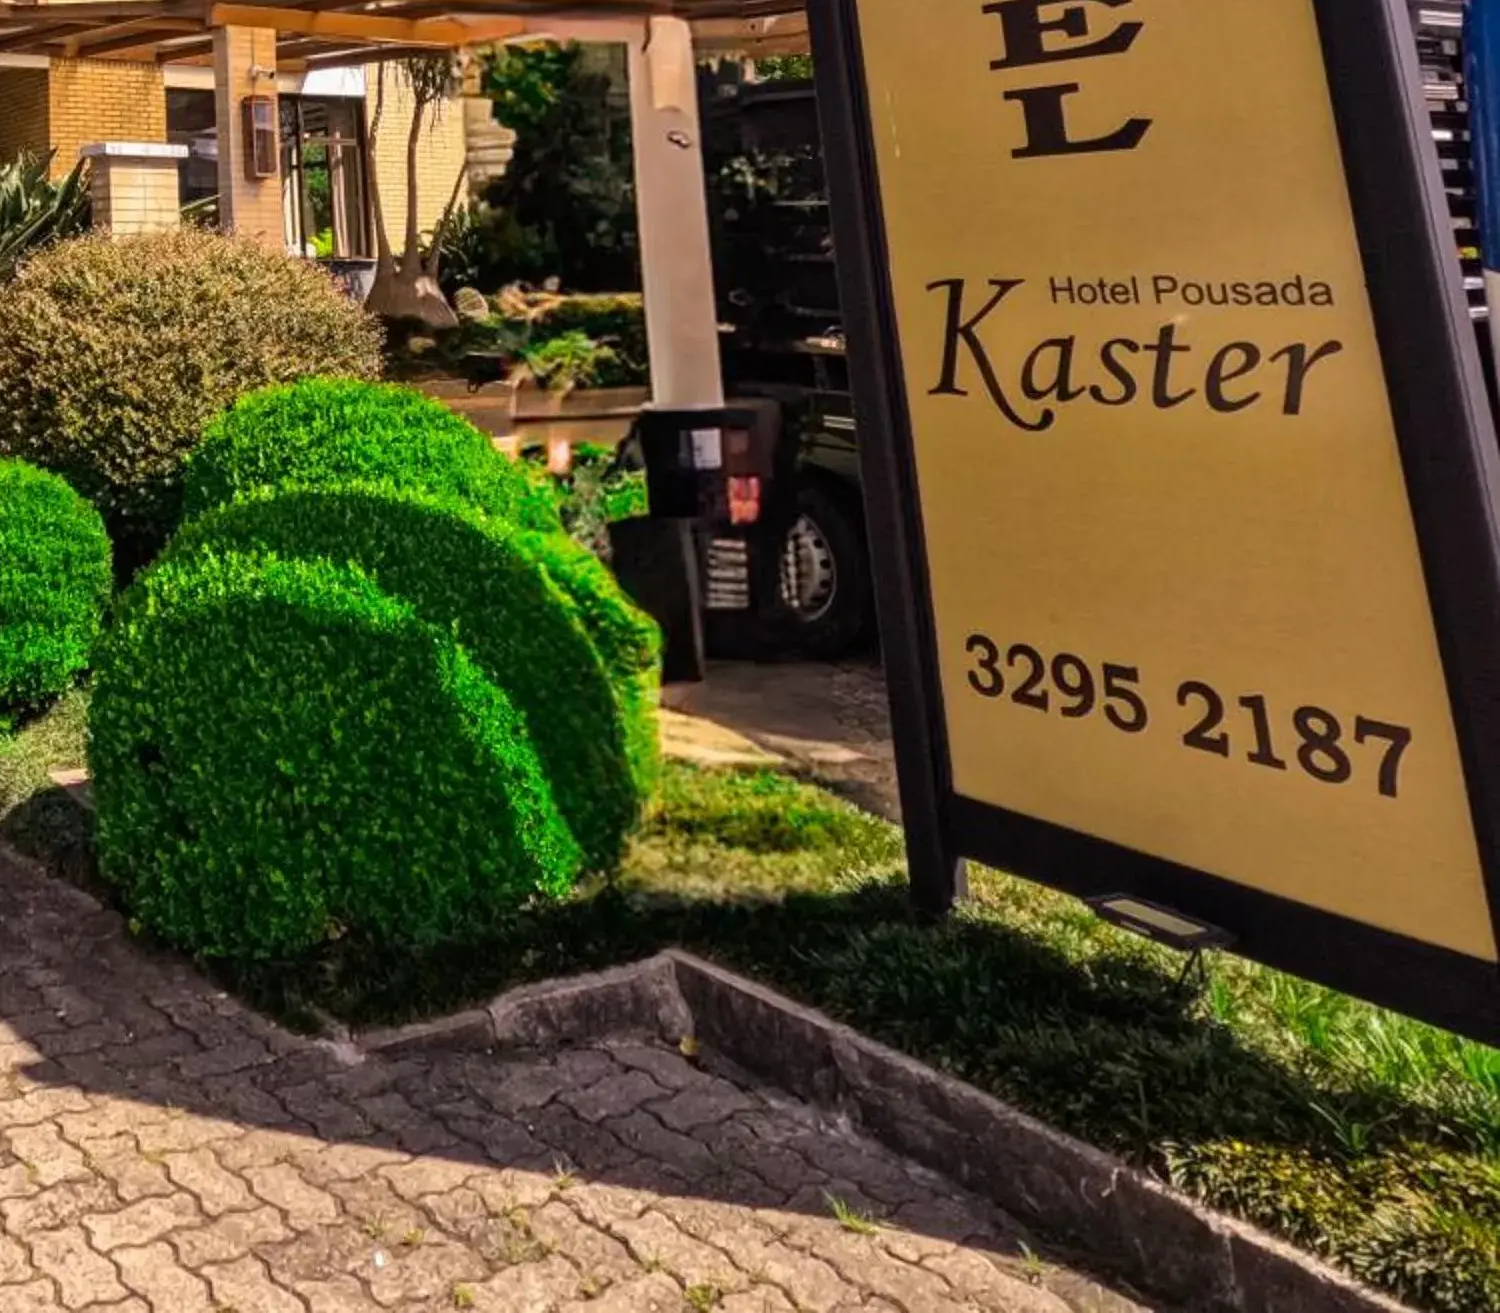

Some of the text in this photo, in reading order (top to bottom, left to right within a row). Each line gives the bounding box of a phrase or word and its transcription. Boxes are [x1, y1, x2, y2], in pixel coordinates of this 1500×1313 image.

[926, 278, 1341, 430] Kaster
[1050, 275, 1333, 306] Hotel Pousada
[965, 634, 1411, 797] 3295 2187
